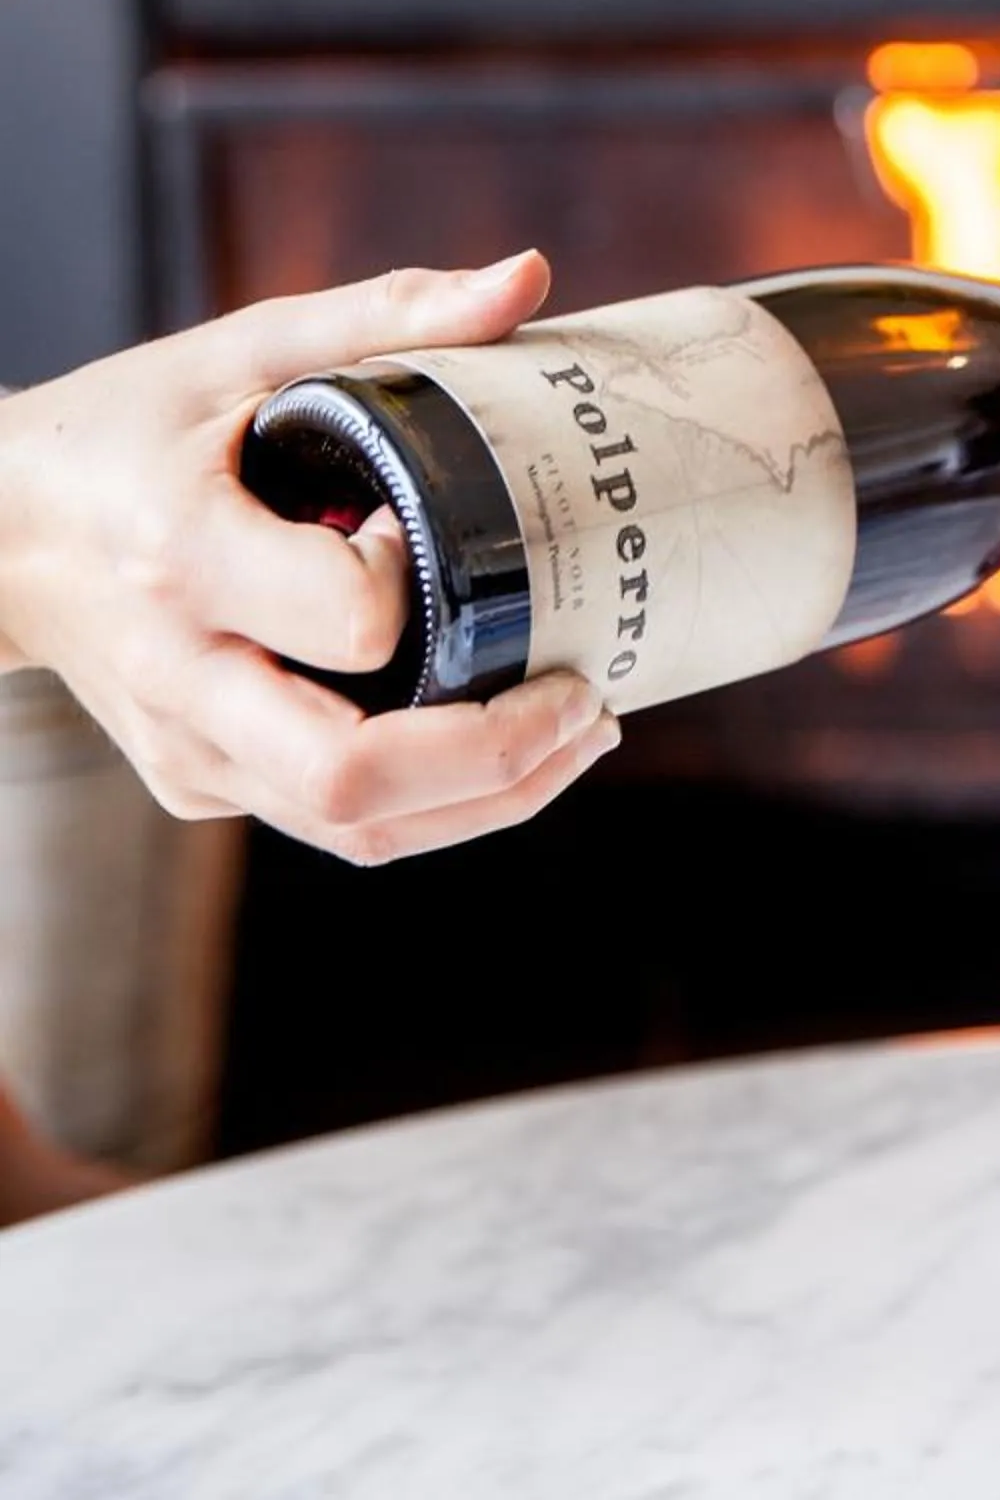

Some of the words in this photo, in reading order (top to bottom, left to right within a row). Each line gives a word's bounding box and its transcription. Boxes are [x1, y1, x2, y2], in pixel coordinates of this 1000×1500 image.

[540, 361, 650, 681] Polperro
[541, 452, 576, 531] PINOT
[568, 547, 584, 611] NOIR
